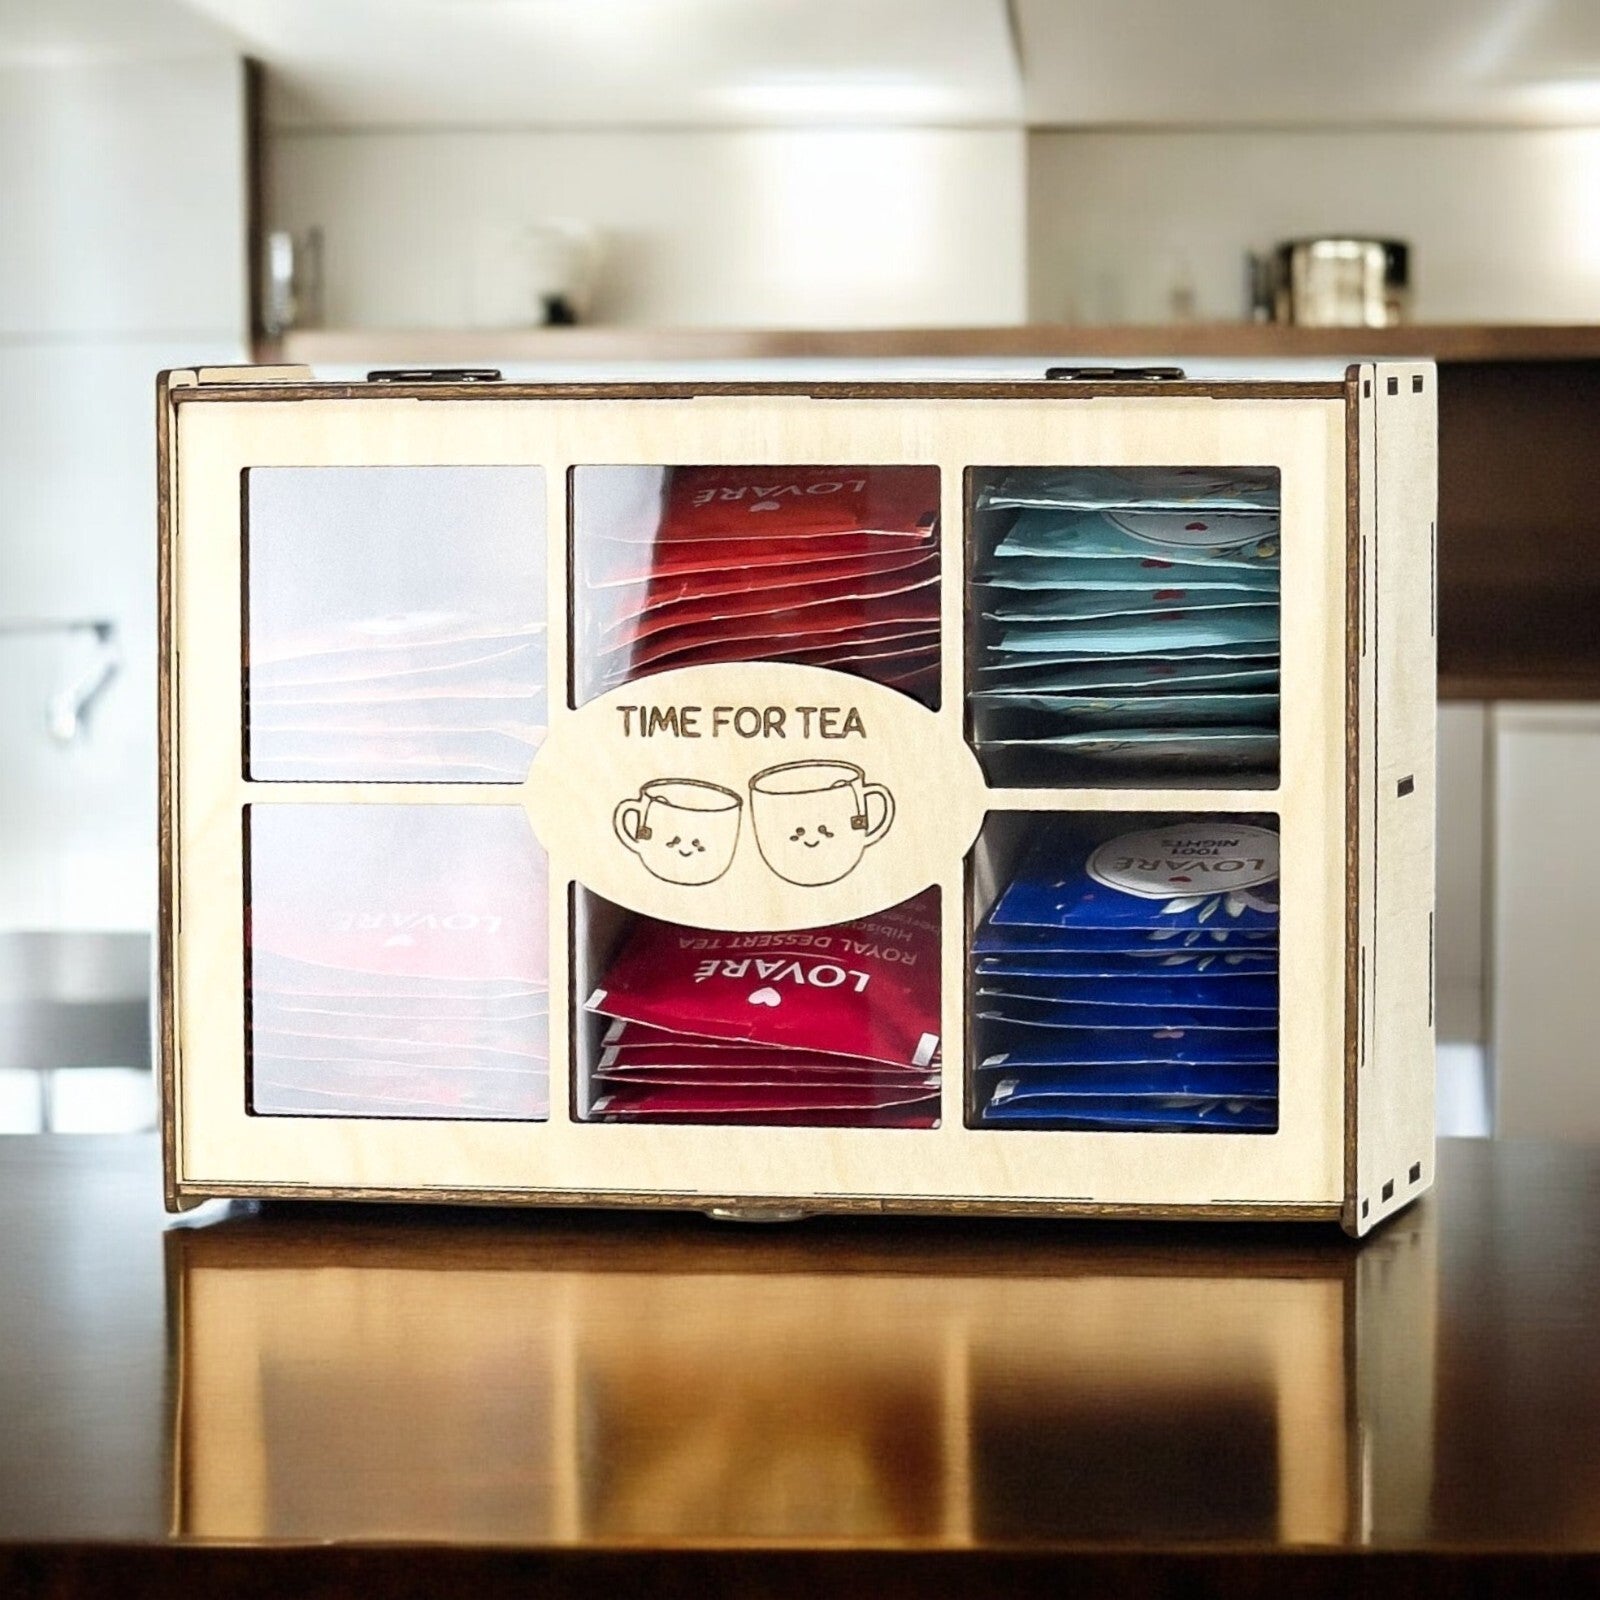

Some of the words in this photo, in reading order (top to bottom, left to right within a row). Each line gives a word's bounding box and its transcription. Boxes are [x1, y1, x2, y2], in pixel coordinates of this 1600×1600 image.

[693, 479, 867, 508] LOVARÉ
[616, 705, 702, 738] TIME
[712, 706, 786, 739] FOR
[795, 706, 867, 739] TEA
[1161, 839, 1240, 848] NIGHTS
[1171, 848, 1221, 856] 1001
[1112, 856, 1266, 873] LOVARÉ
[678, 936, 722, 950] TEA
[726, 933, 833, 949] DESSERT
[840, 938, 918, 966] ROYAL
[693, 958, 871, 993] LOVARÉ
